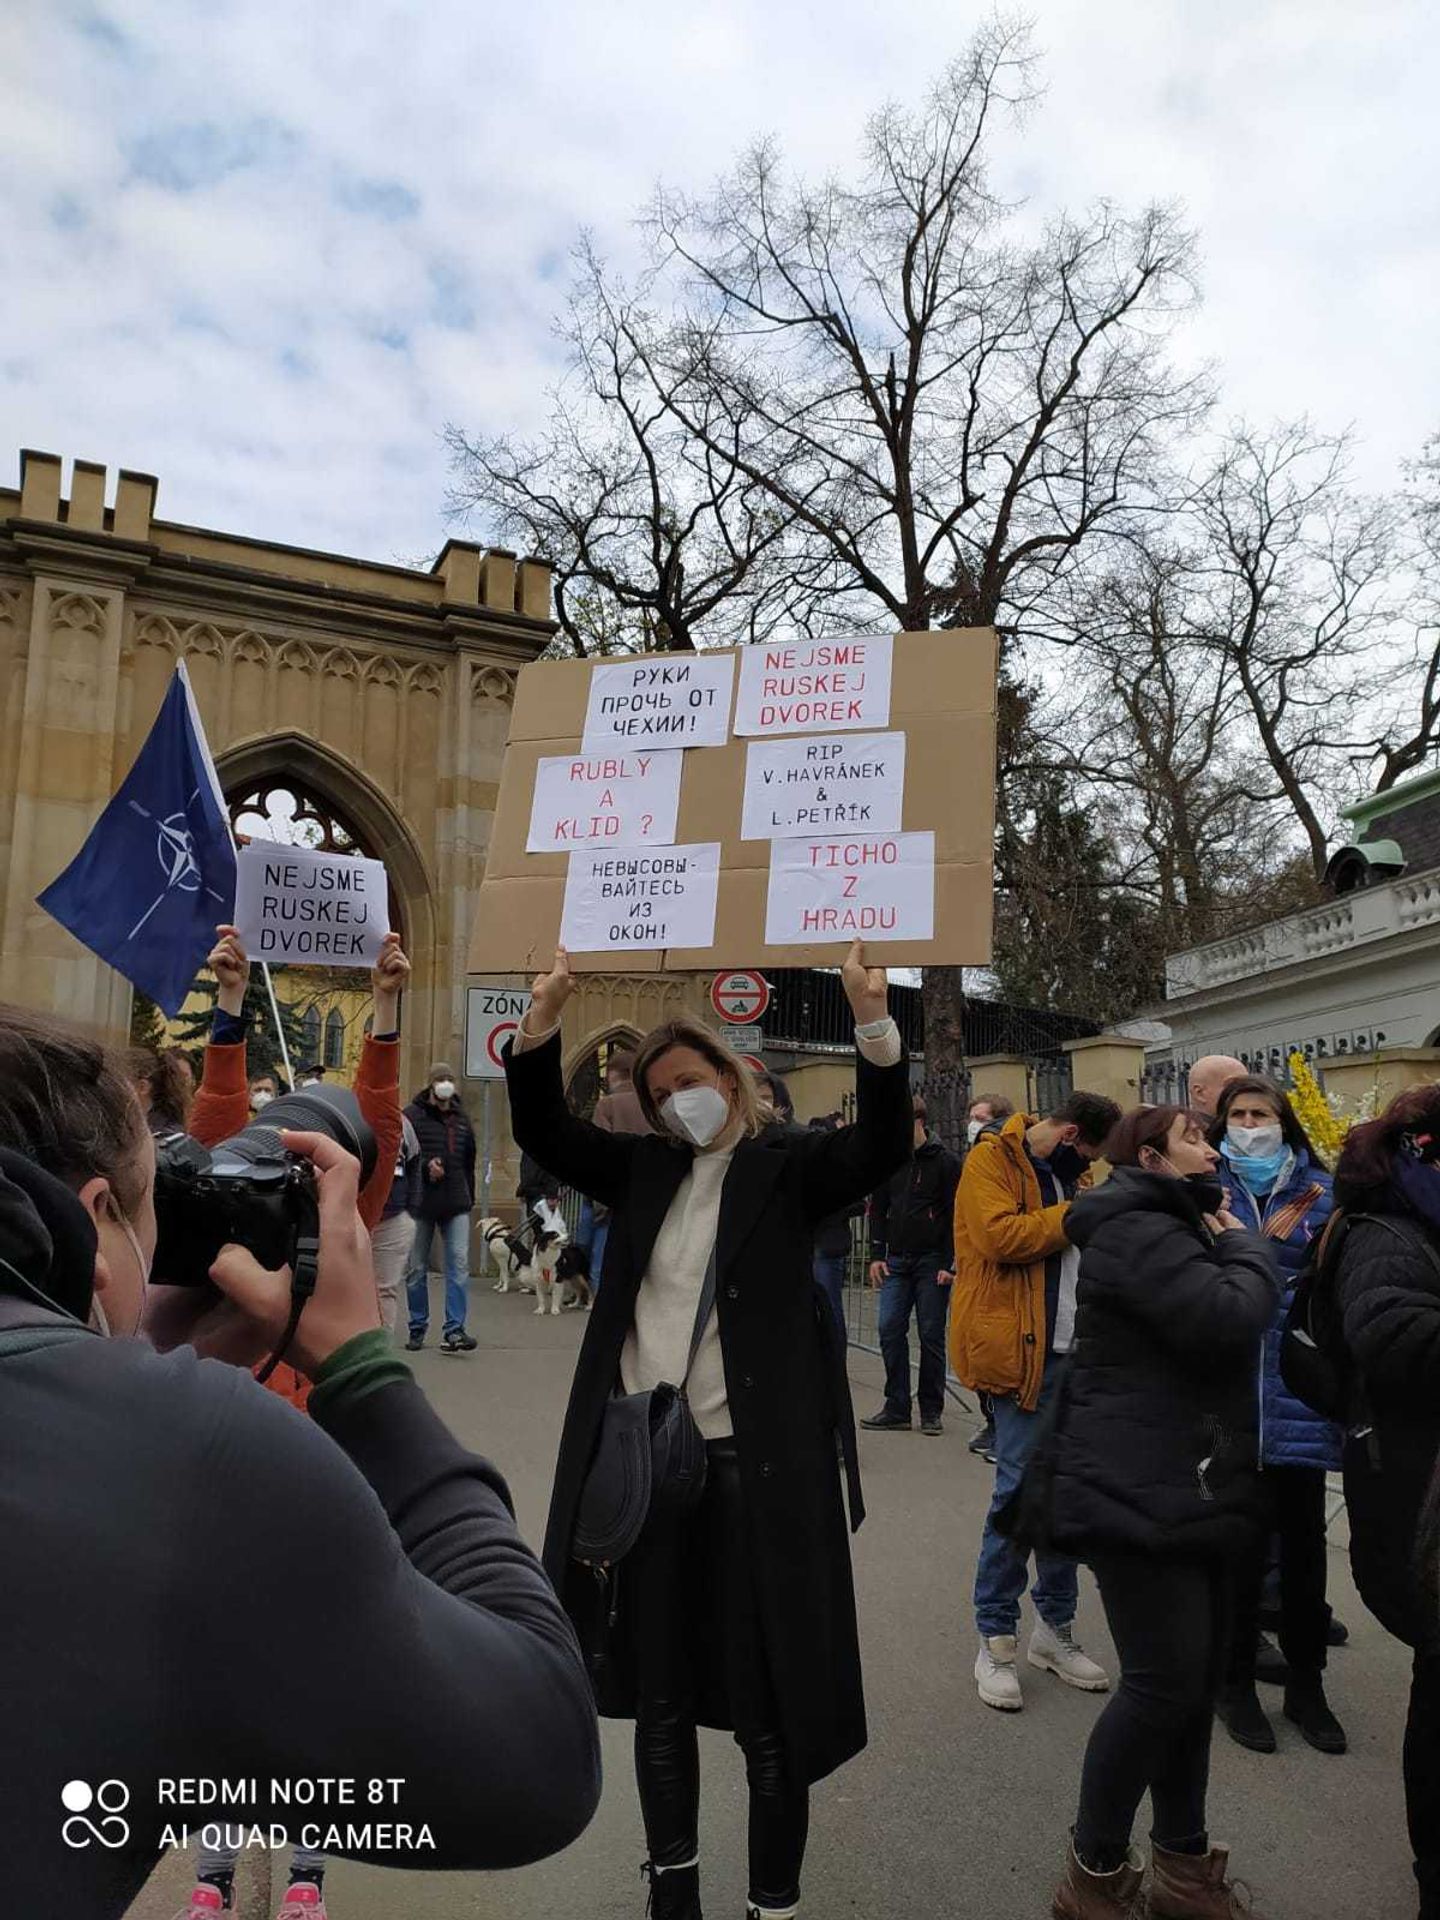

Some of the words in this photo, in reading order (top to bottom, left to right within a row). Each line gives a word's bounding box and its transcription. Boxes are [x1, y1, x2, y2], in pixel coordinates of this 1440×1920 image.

[766, 645, 866, 670] NEJSME
[633, 665, 690, 687] РУКИ
[763, 672, 865, 697] RUSKEJ
[601, 692, 672, 714] ПРОЧЬ
[689, 689, 718, 707] ОТ
[760, 700, 863, 725] DVOREK
[613, 715, 696, 736] ЧЕХИИ!
[807, 745, 843, 760] RIP
[570, 758, 651, 781] RUBLY
[599, 789, 613, 807] A
[816, 787, 827, 801] &
[555, 816, 619, 839] KLID
[808, 842, 897, 867] TICHO
[264, 864, 365, 891] NEJSME
[592, 858, 696, 877] НЕВЫСОВЫ-
[602, 878, 684, 897] ВАЙТЕСЬ
[843, 876, 857, 897] Z
[262, 897, 368, 924] RUSKEJ
[629, 902, 652, 917] ИЗ
[803, 907, 896, 931] HRADU
[260, 929, 365, 954] DVOREK
[609, 924, 665, 940] ОКОН!
